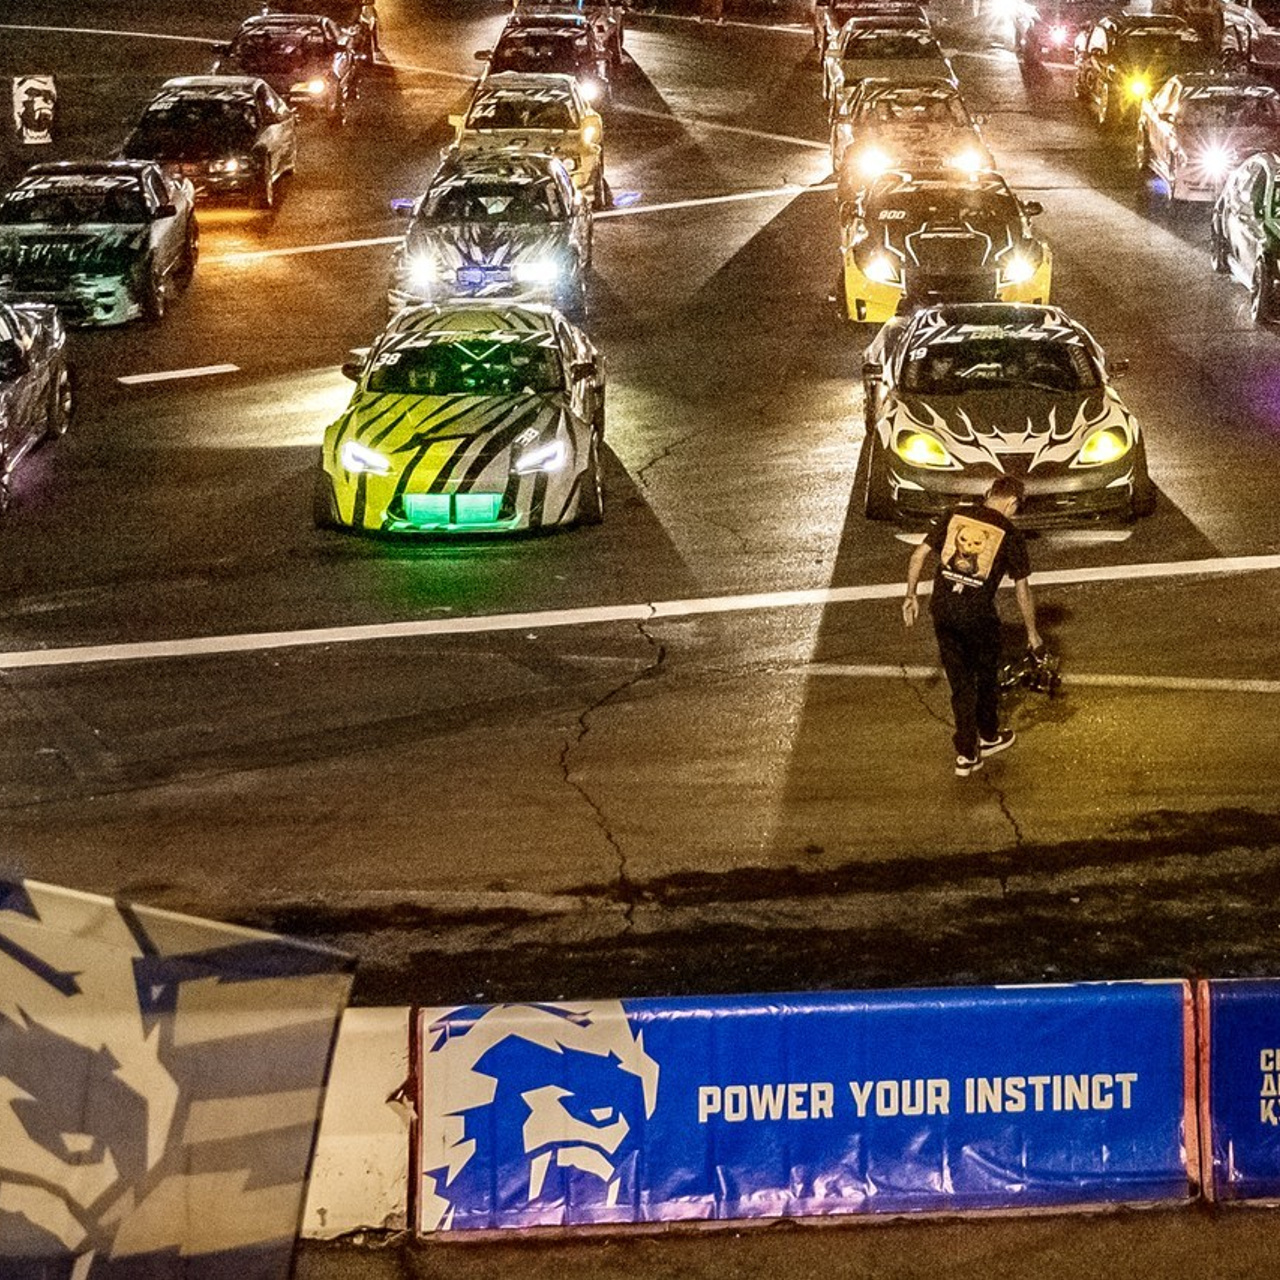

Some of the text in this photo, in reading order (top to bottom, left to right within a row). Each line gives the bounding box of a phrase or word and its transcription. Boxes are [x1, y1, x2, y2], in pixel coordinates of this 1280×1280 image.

[878, 210, 906, 220] 900
[376, 352, 401, 366] 38
[909, 347, 928, 362] 19
[514, 427, 540, 446] 38
[698, 1072, 1139, 1124] POWER YOUR INSTINCT
